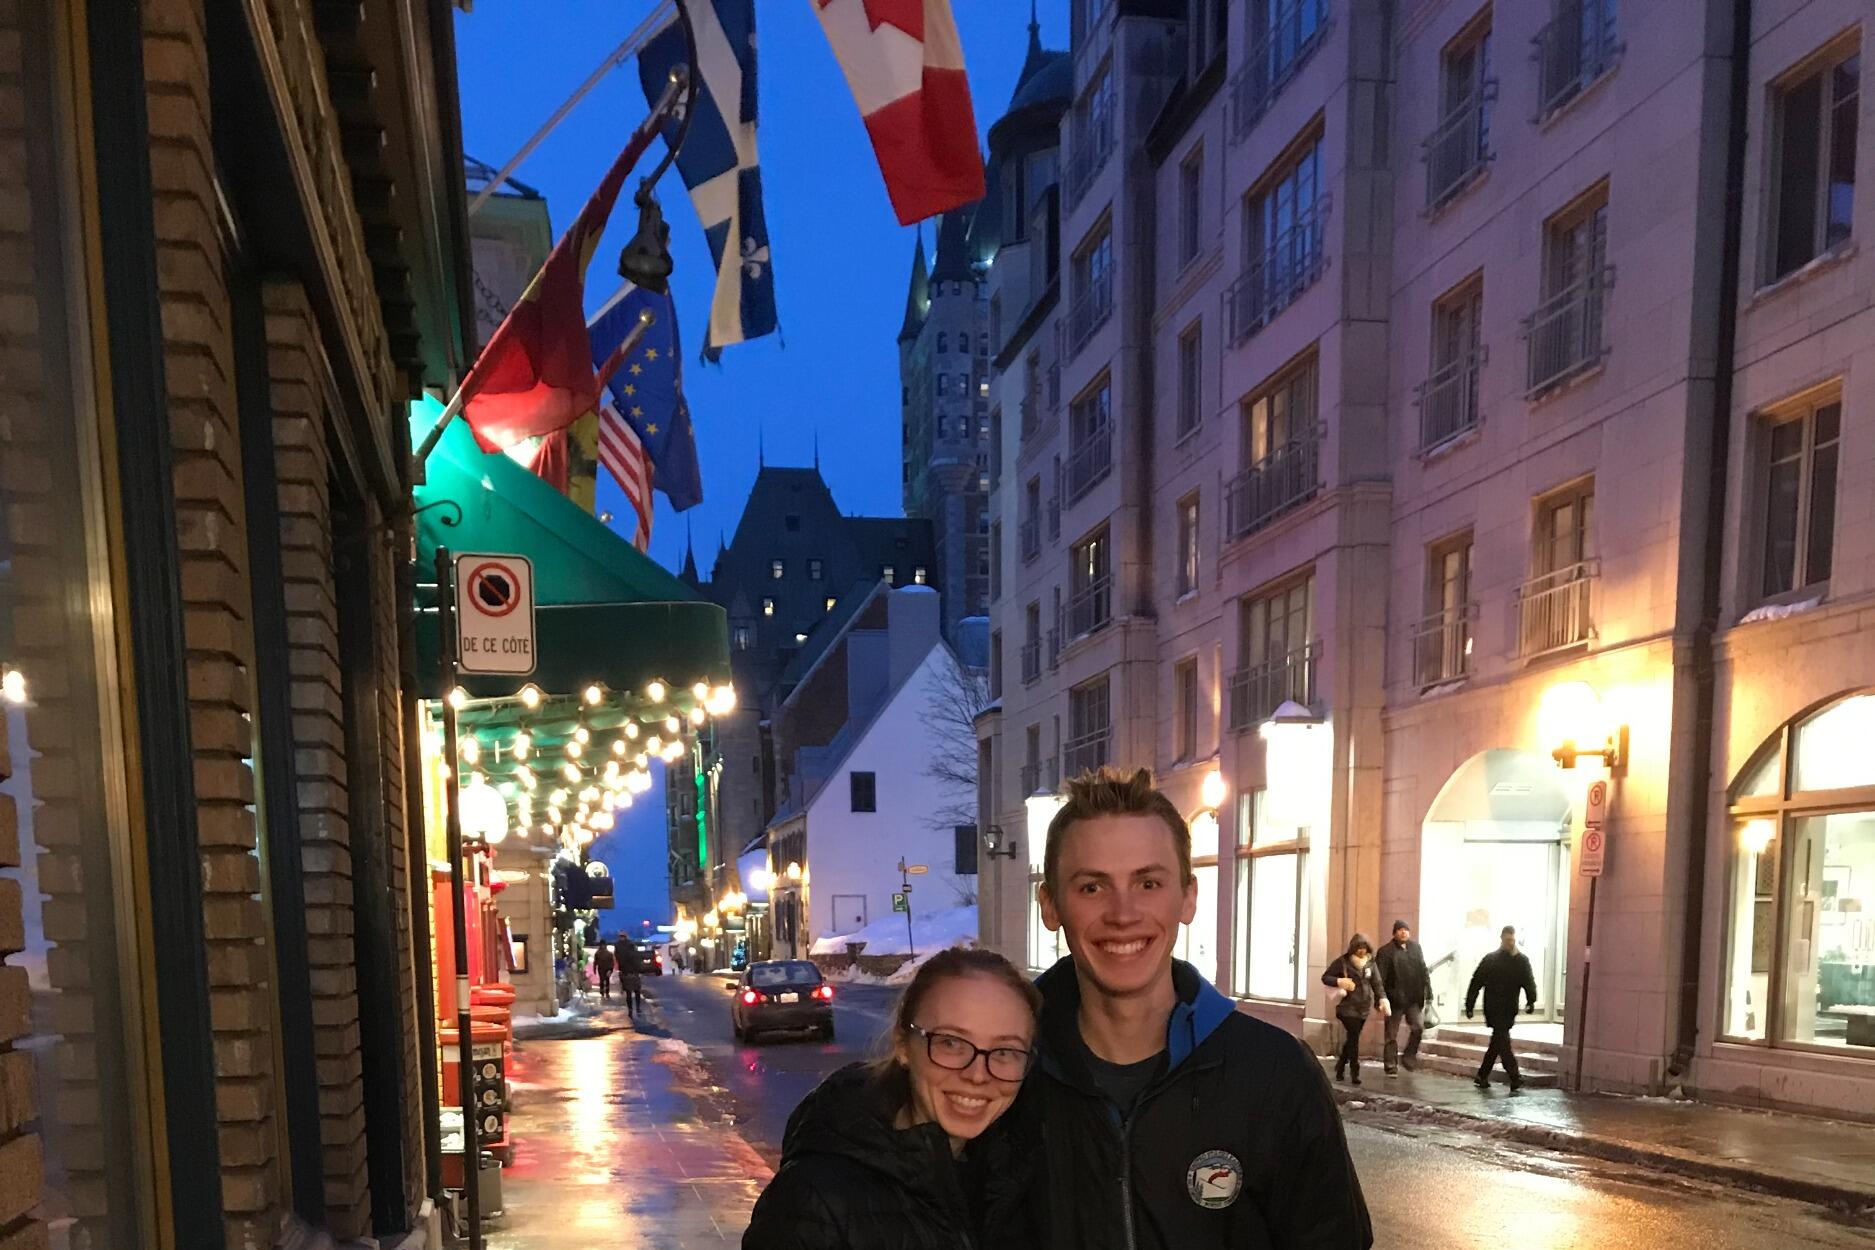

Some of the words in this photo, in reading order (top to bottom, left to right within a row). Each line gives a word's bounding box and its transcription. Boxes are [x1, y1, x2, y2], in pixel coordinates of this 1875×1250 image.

[463, 637, 478, 652] DE
[482, 637, 498, 653] CE
[894, 894, 903, 905] P
